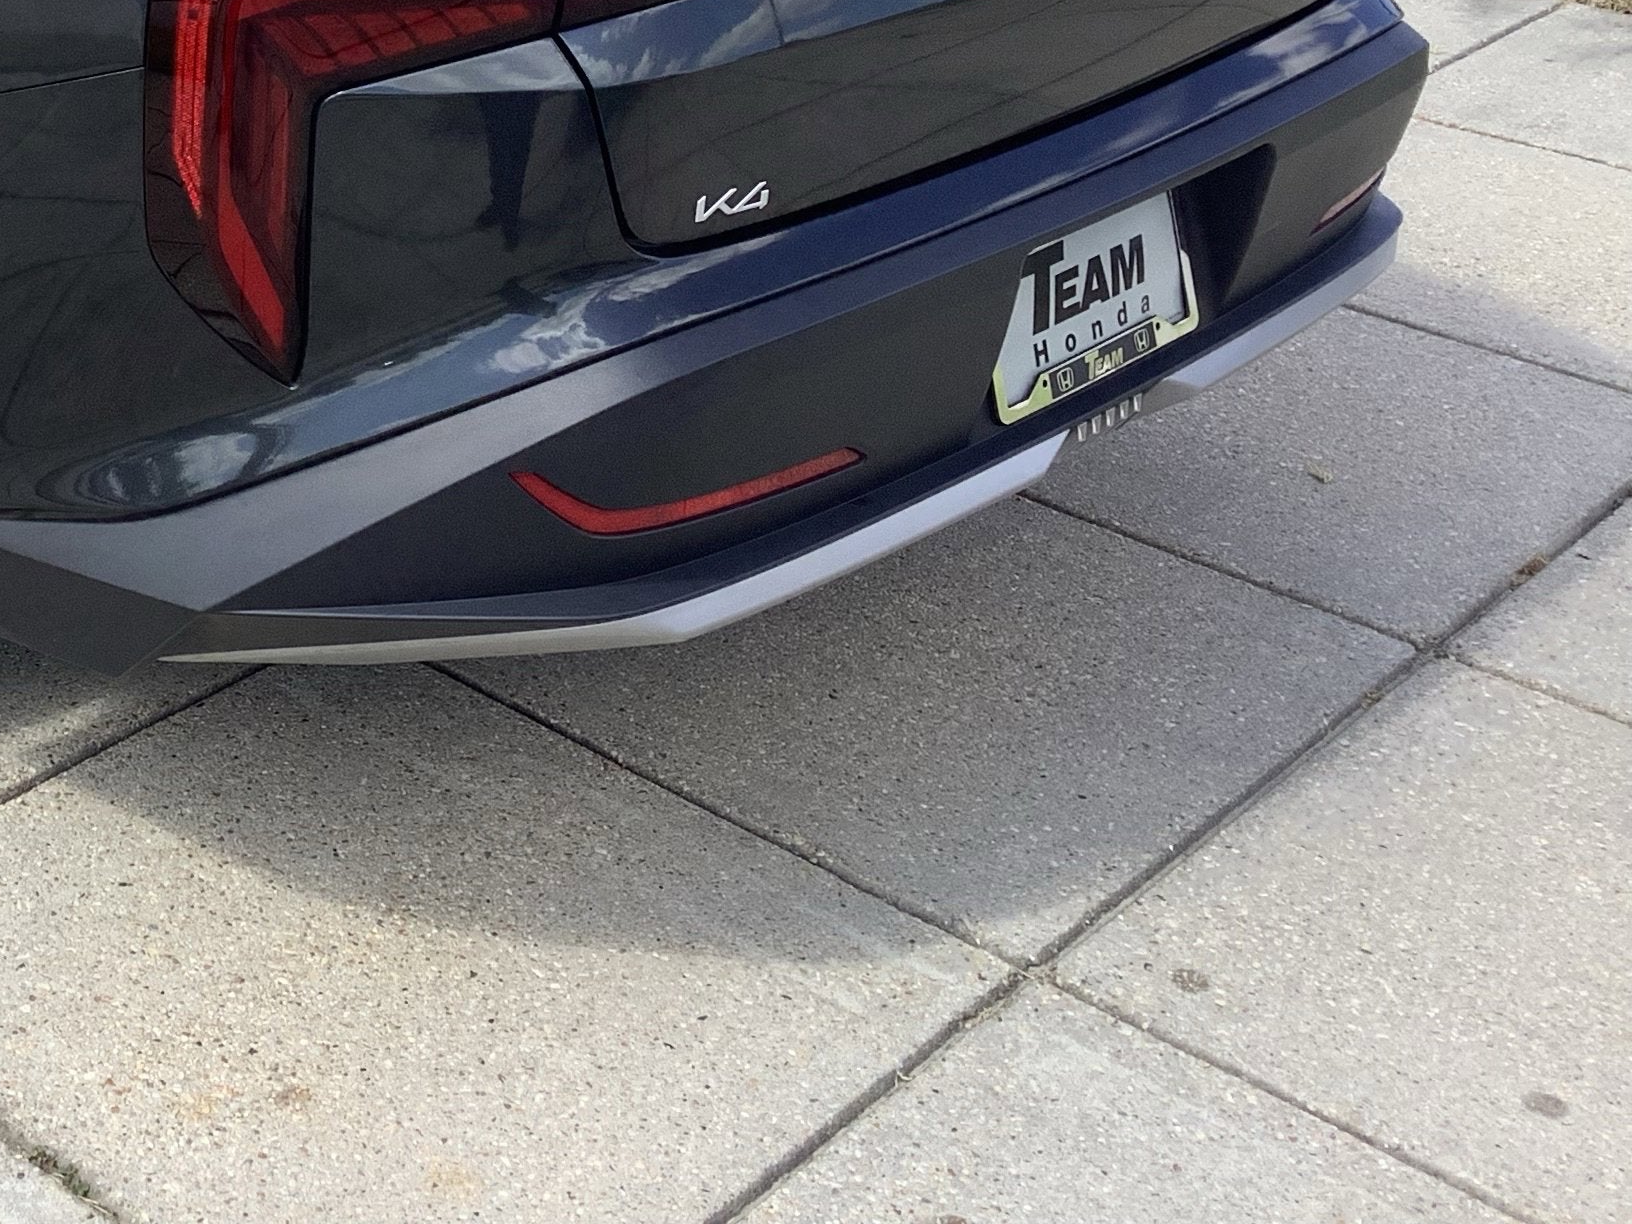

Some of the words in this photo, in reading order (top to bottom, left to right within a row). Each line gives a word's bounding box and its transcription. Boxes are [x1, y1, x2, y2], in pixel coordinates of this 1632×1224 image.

[1020, 233, 1146, 336] TEAM
[1032, 294, 1151, 368] Honda
[1084, 347, 1124, 380] TEAM
